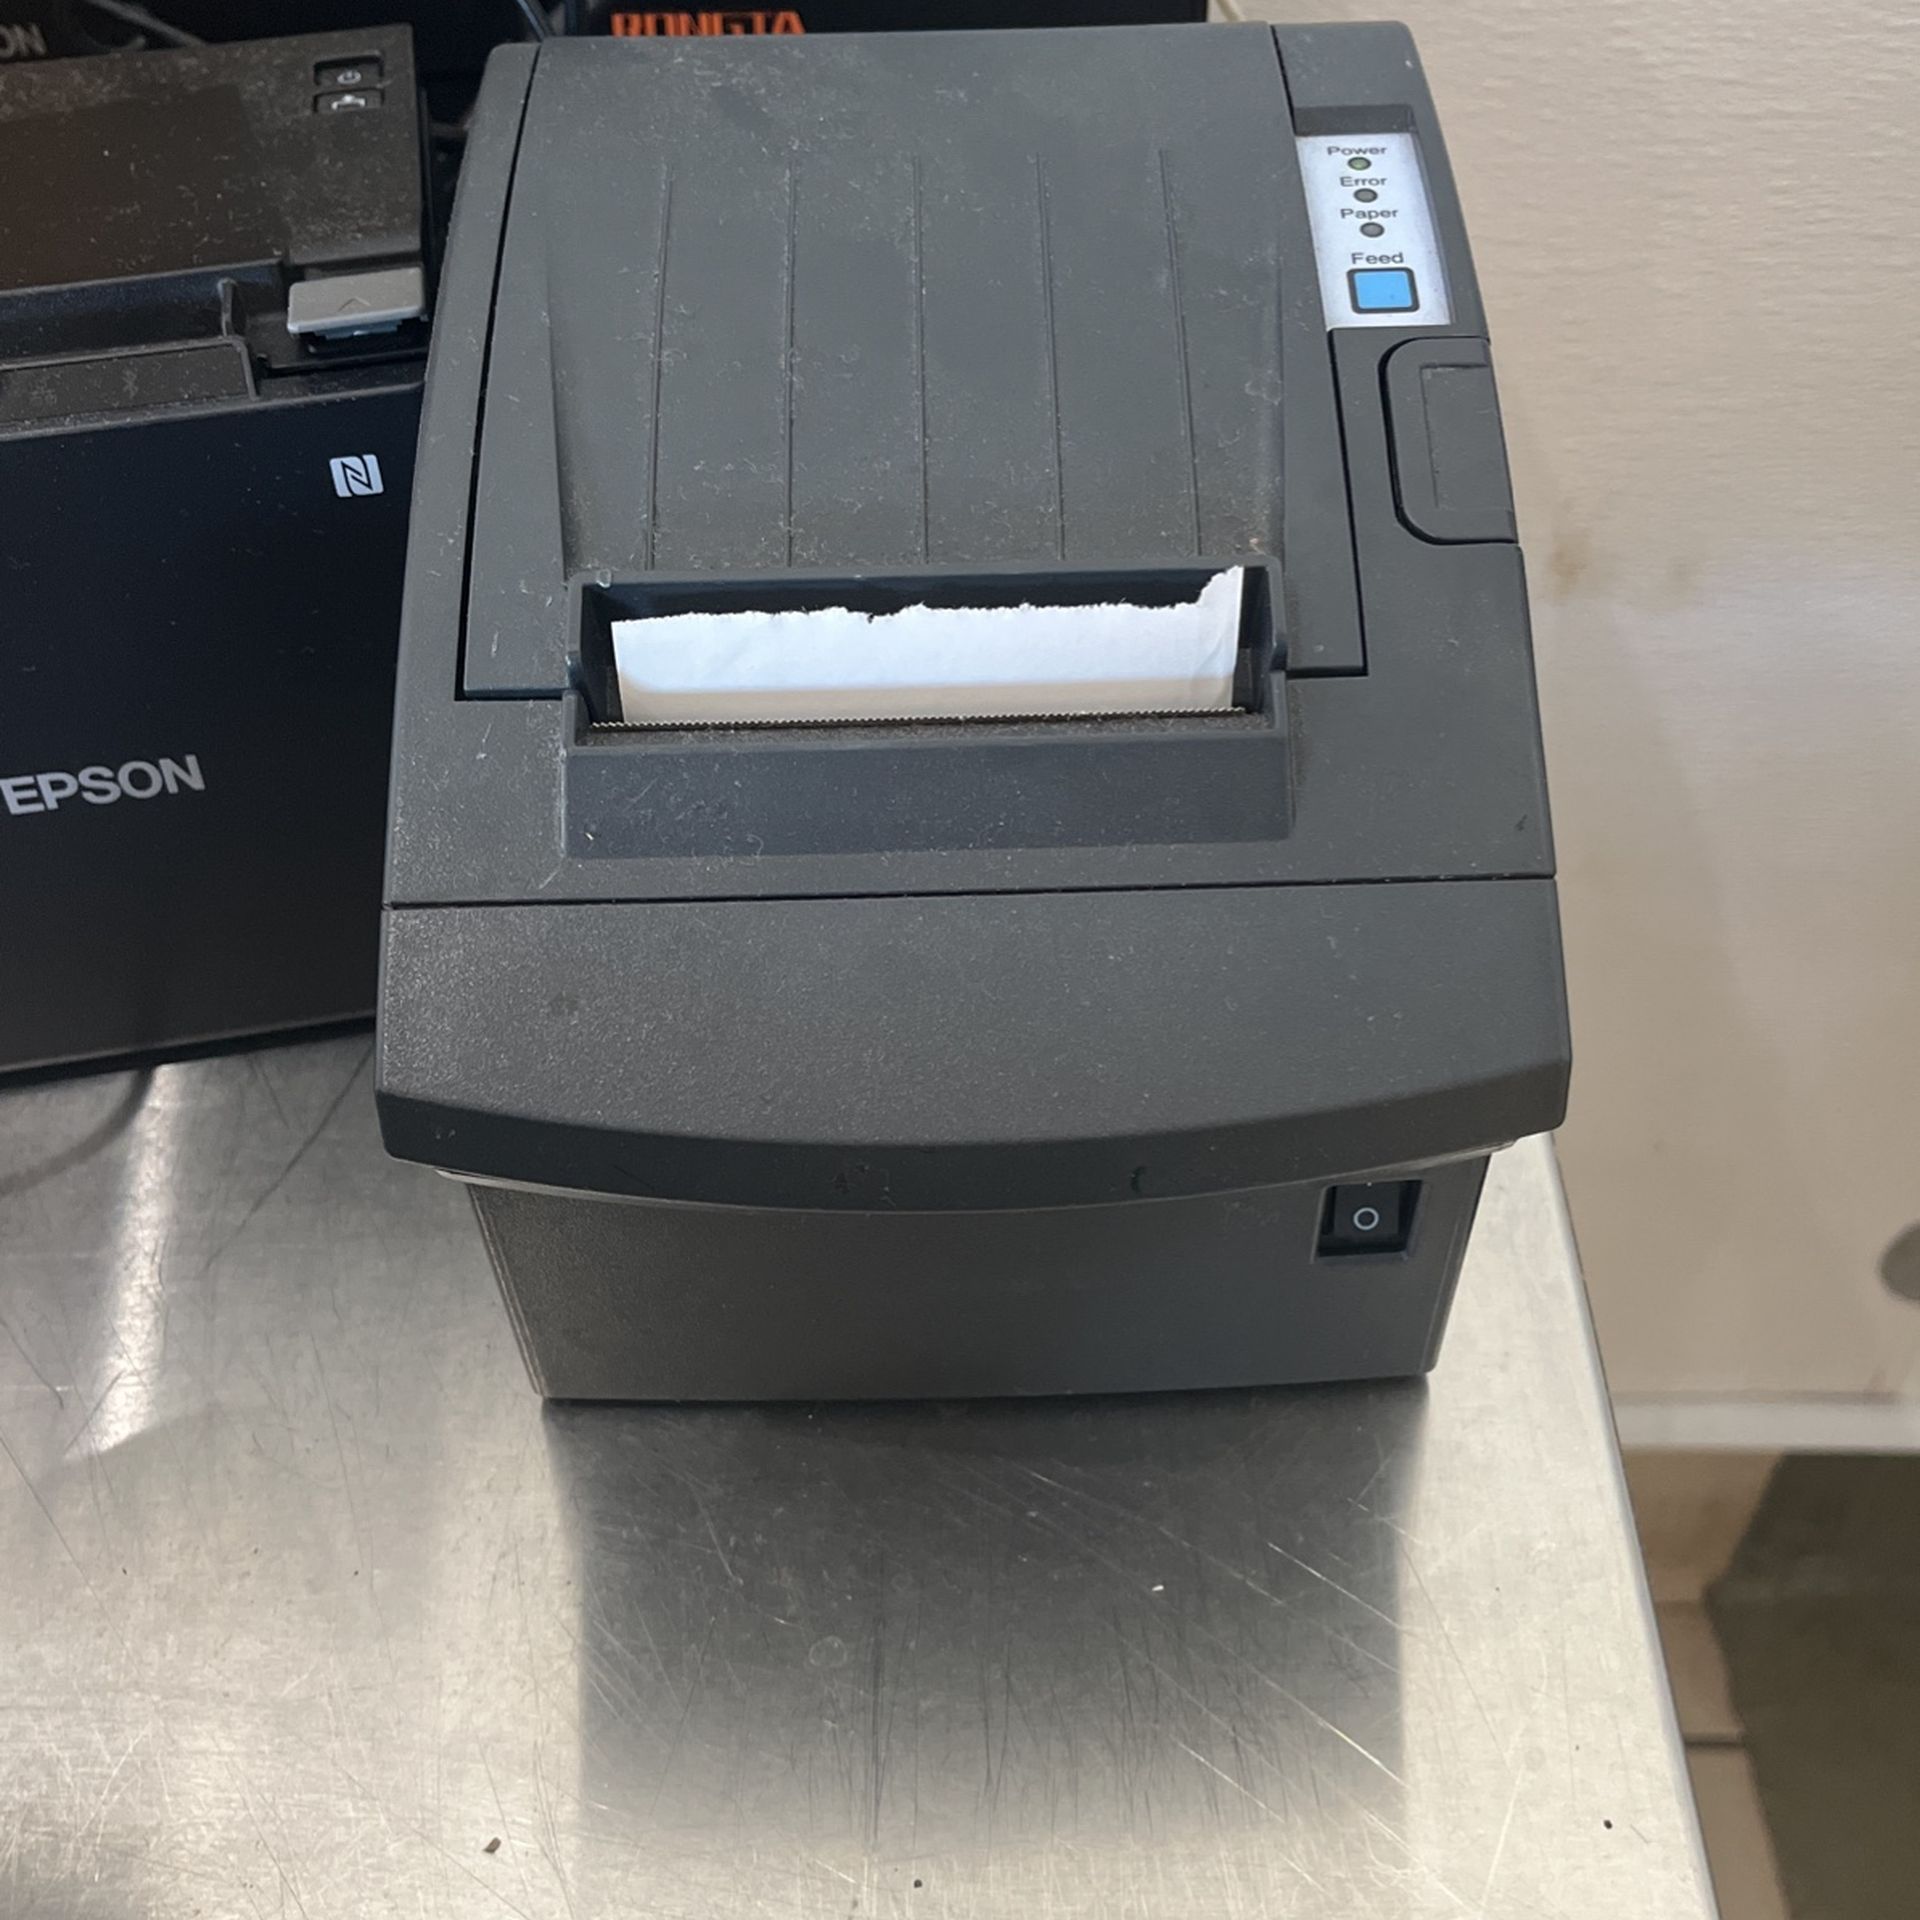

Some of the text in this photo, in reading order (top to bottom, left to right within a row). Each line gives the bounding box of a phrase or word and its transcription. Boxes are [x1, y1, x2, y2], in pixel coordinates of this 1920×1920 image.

[1327, 145, 1388, 156] Power
[1340, 176, 1388, 187] Error
[1340, 208, 1399, 220] Paper
[1351, 252, 1404, 264] Feed
[0, 754, 206, 815] EPSON
